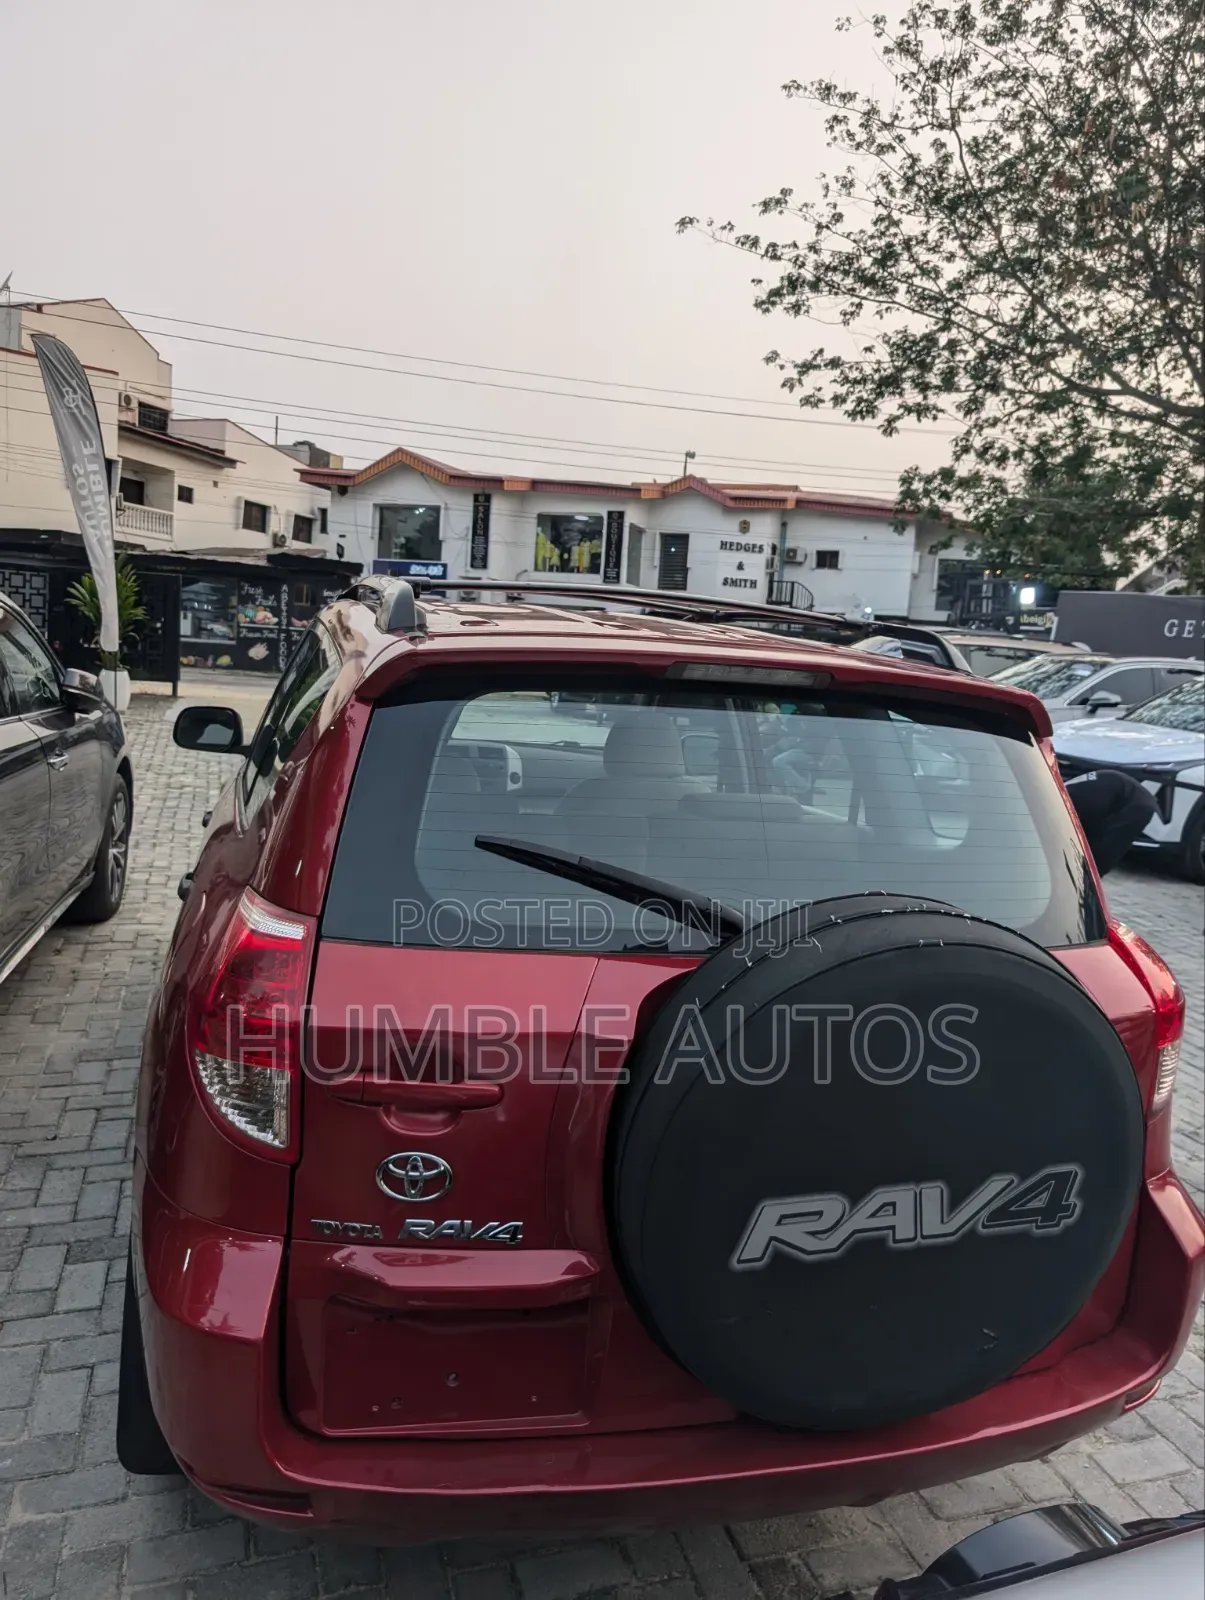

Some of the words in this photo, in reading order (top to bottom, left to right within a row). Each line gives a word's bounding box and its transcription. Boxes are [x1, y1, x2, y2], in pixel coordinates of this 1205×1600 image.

[476, 506, 485, 535] SALON
[609, 522, 618, 568] BOUTIQUE
[720, 540, 764, 553] HEDGES
[737, 561, 744, 570] &
[722, 577, 757, 589] SMITH
[1163, 618, 1205, 639] GE
[729, 1162, 1085, 1272] RAV4
[310, 1219, 383, 1240] TOYOTA
[398, 1218, 524, 1245] RAV4
